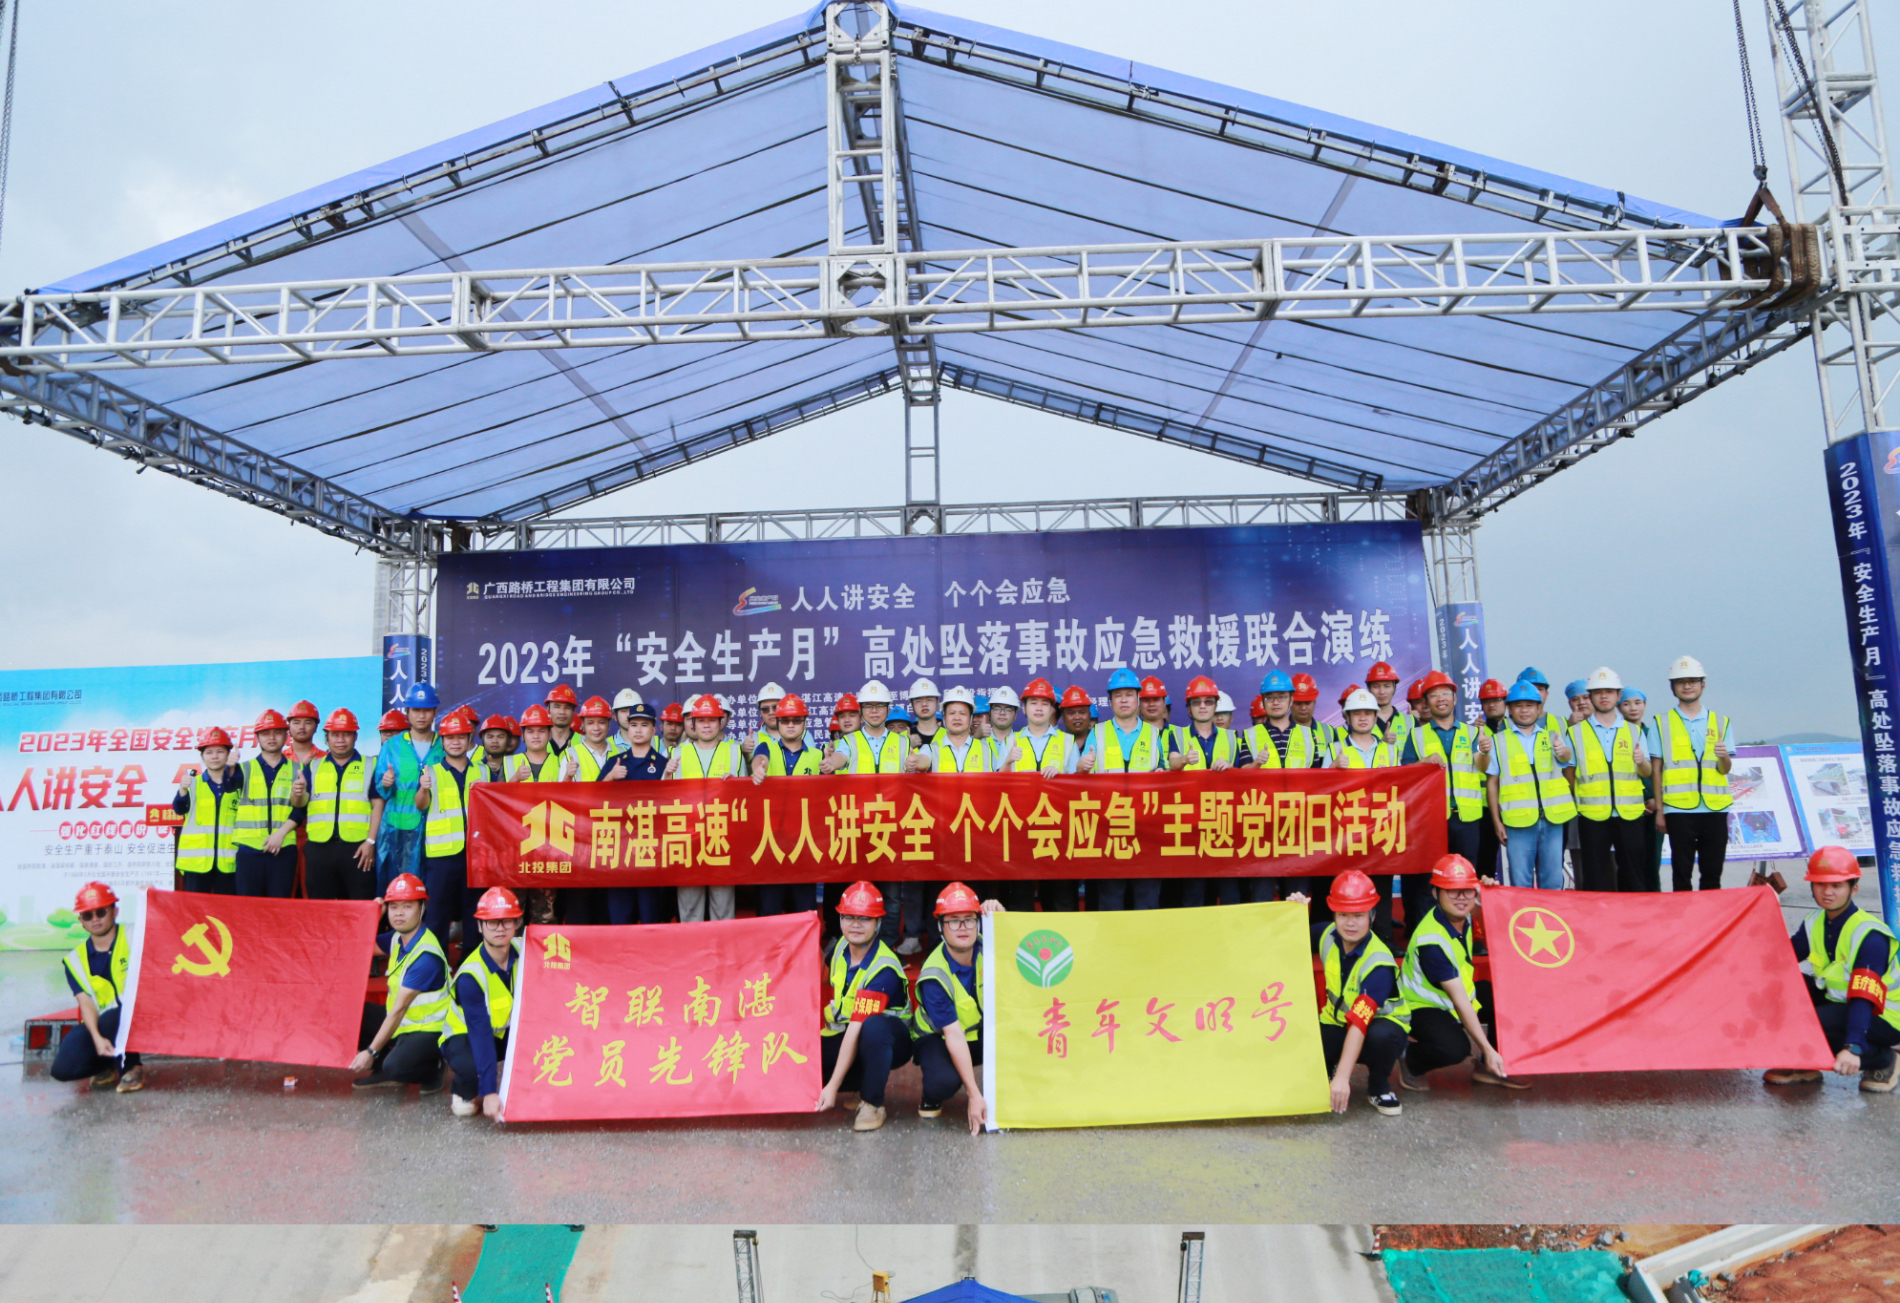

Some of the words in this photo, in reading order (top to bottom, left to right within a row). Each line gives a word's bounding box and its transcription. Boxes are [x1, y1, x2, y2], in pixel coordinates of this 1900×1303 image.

[483, 577, 636, 595] 广西路桥工程集团有限公司
[791, 582, 915, 612] 人人讲安全
[944, 577, 1070, 607] 个个会应急
[518, 862, 572, 874] 北投集团
[543, 961, 571, 971] 北投集团
[565, 972, 776, 1030] 智联南湛
[1038, 981, 1293, 1059] 青年文明号
[533, 1030, 808, 1088] 党员先锋队
